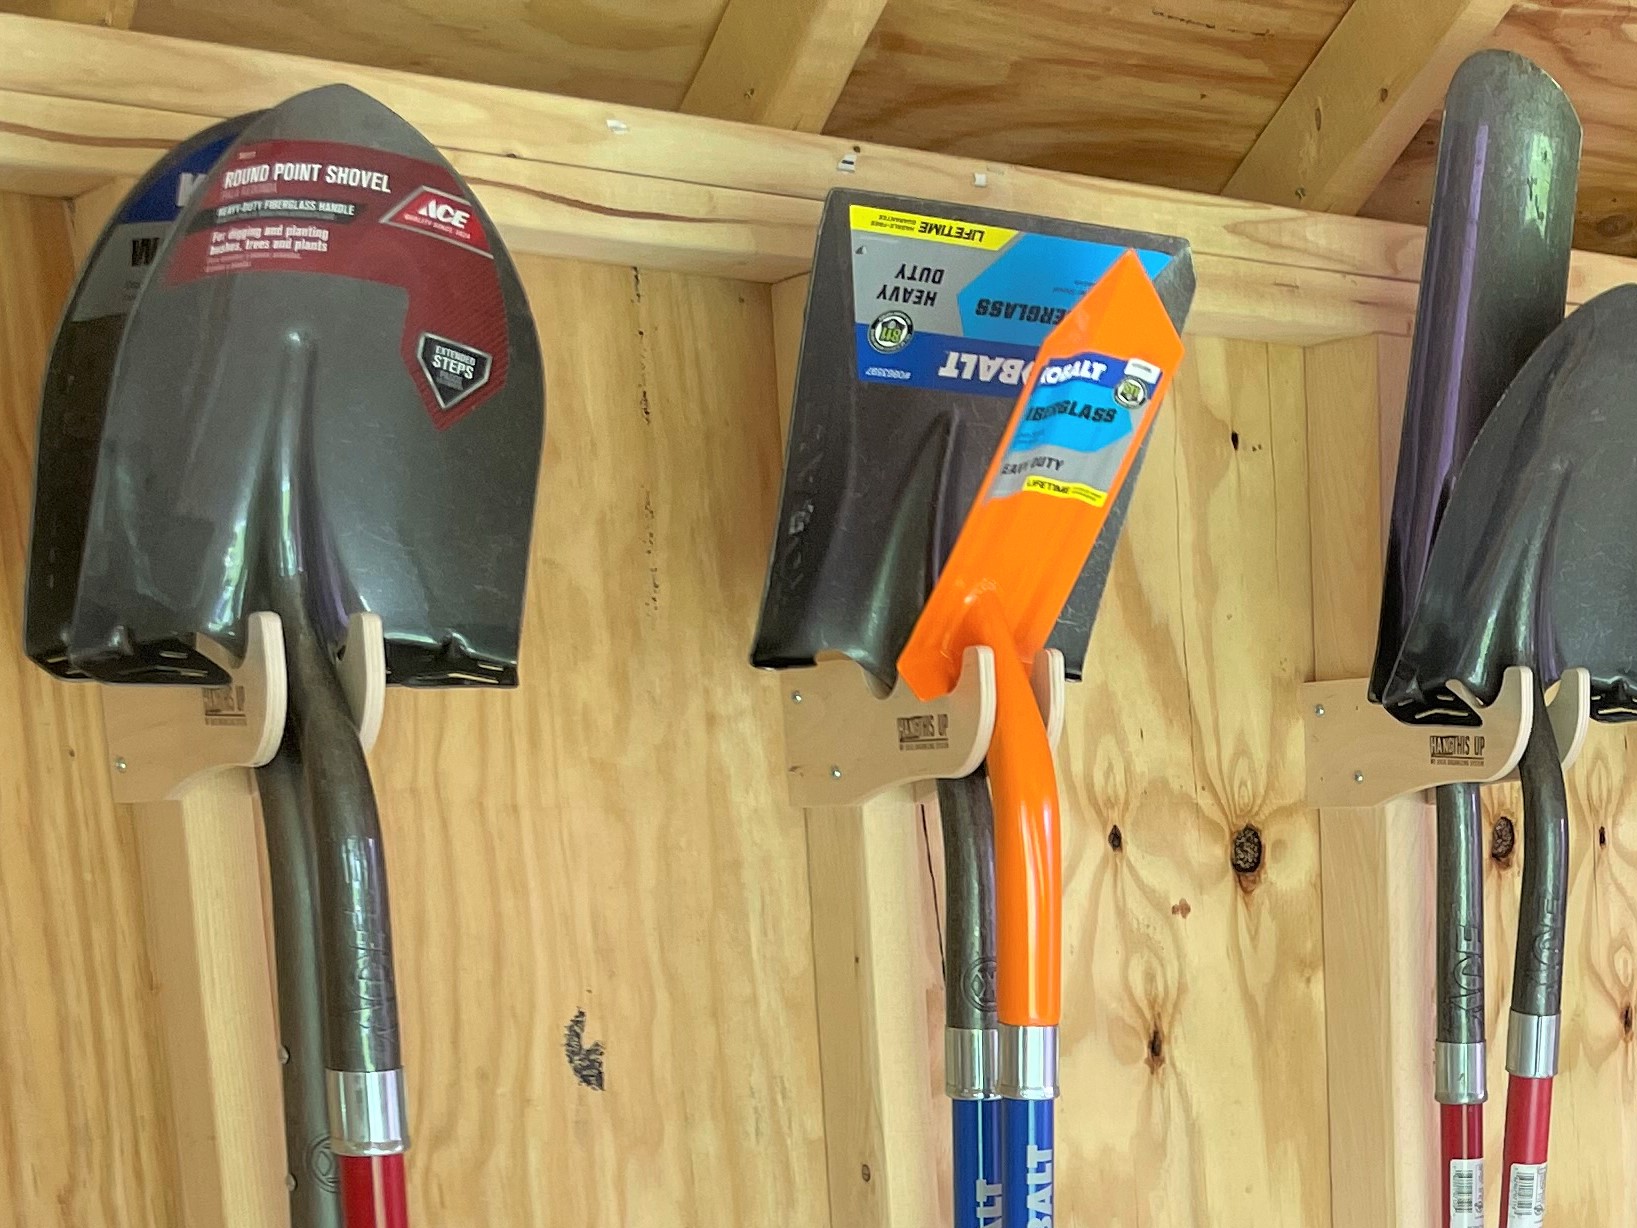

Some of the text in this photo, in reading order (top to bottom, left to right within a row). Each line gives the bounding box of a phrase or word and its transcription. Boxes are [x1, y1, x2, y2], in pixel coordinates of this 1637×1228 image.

[224, 164, 270, 190] ROUND
[273, 163, 323, 182] POINT
[325, 165, 391, 194] SHOVEL
[318, 201, 355, 216] HANDLE
[418, 199, 470, 230] ACE
[264, 224, 283, 236] and
[285, 225, 330, 242] planting
[918, 221, 985, 243] LIFETIME
[245, 238, 270, 250] trees
[272, 238, 292, 249] and
[294, 238, 328, 252] plants
[895, 263, 945, 285] DUTY
[876, 284, 938, 307] HEAVY
[975, 298, 1067, 325] ERGLASS
[432, 354, 474, 379] STEPS
[435, 345, 476, 366] EXTENDED
[938, 350, 1034, 386] BALT
[1474, 736, 1485, 756] UP
